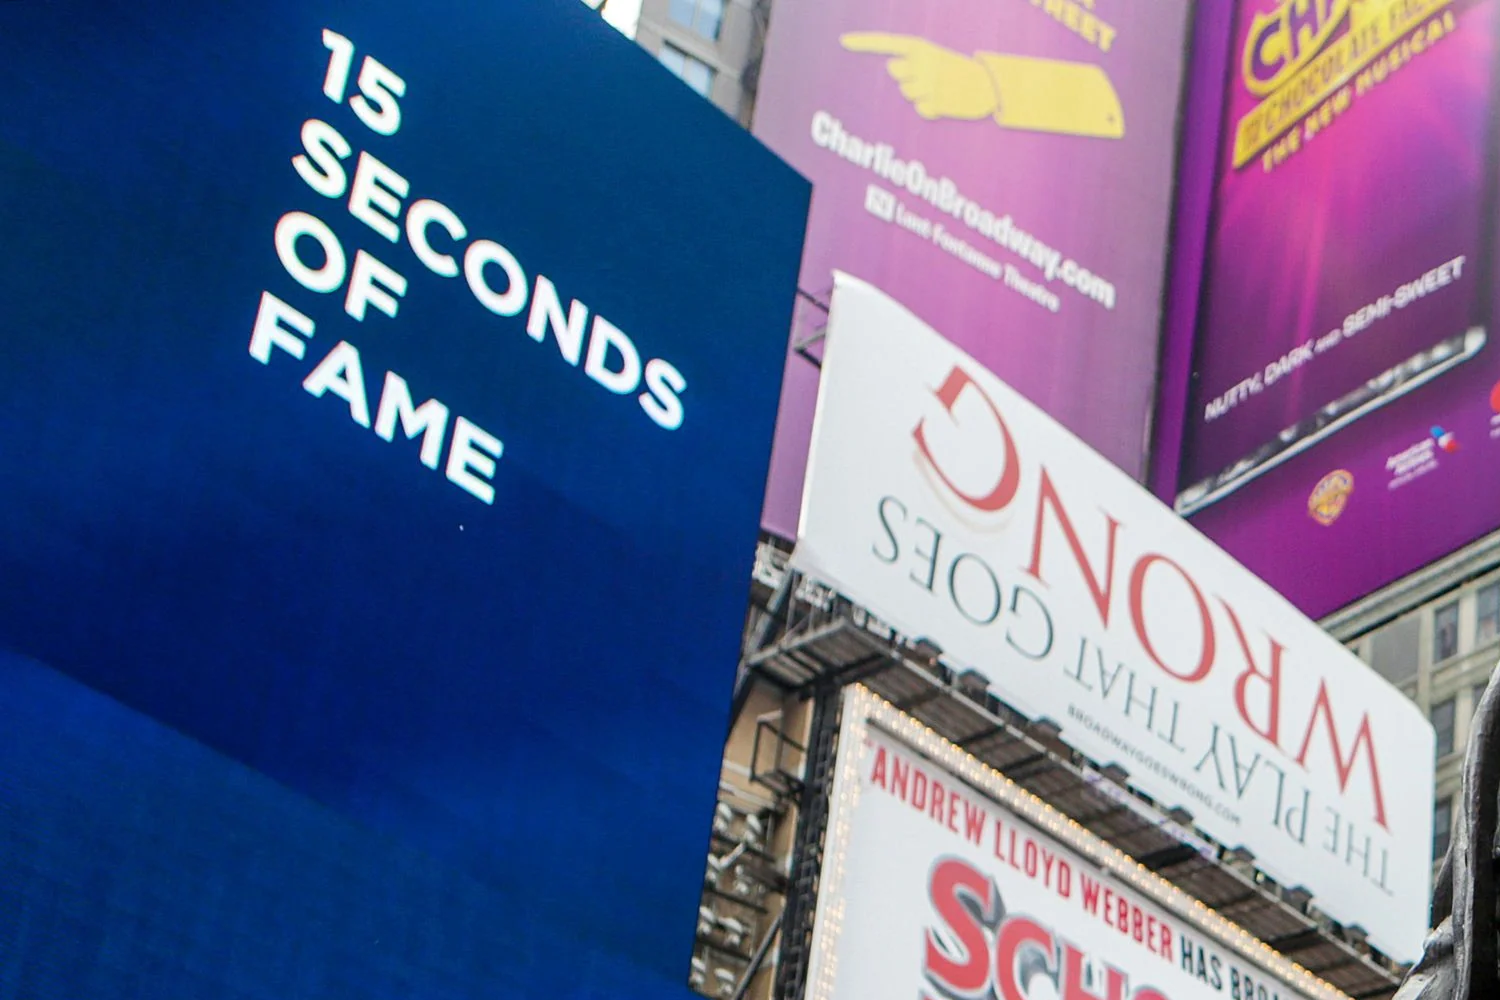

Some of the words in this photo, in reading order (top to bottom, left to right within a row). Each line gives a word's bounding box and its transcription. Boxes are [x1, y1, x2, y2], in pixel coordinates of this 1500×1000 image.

[322, 28, 406, 136] 15
[274, 211, 408, 321] OF
[291, 118, 688, 431] SECONDS
[811, 110, 1116, 309] CharlieOnBroadway.com
[1264, 338, 1315, 386] DARK
[1343, 255, 1466, 338] SEMI-SWEET
[249, 290, 504, 505] FAME
[871, 494, 1055, 662] GOES
[910, 365, 1393, 835] WRONG
[1063, 634, 1188, 738] THAT
[1067, 703, 1242, 826] BROADWAYGOESWRONG.COM
[1195, 719, 1309, 845] PLAY
[993, 819, 1072, 900] LLOYD
[1080, 871, 1175, 965] WEBBER
[1180, 934, 1224, 992] HAS
[1325, 818, 1396, 896] THE
